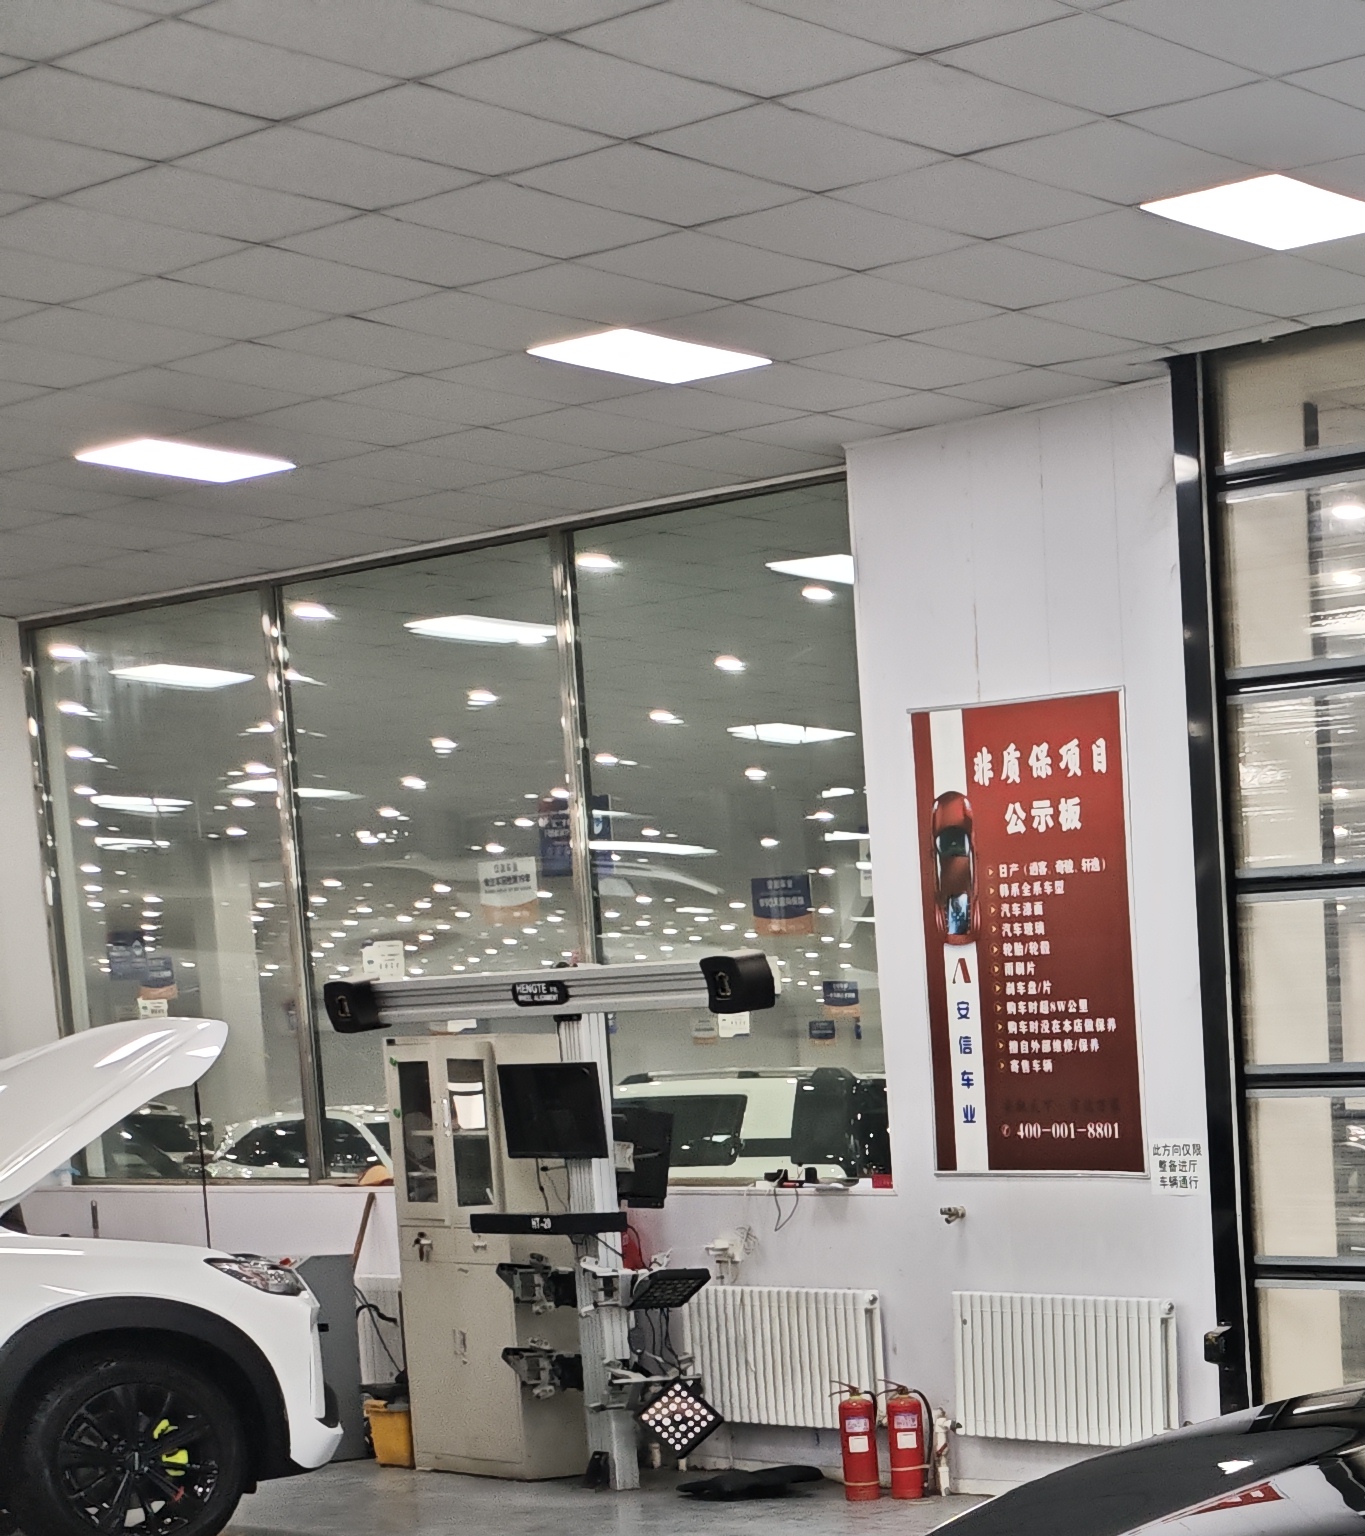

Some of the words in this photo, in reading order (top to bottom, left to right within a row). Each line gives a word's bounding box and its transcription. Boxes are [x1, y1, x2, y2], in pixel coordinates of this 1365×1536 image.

[973, 737, 1107, 787] 非质保项目
[1004, 796, 1082, 835] 公示板
[956, 1000, 977, 1124] 安信车业
[1016, 1122, 1121, 1140] 400-001-8801
[1152, 1143, 1203, 1157] 此方向仅限
[1159, 1175, 1200, 1190] 车辆通行
